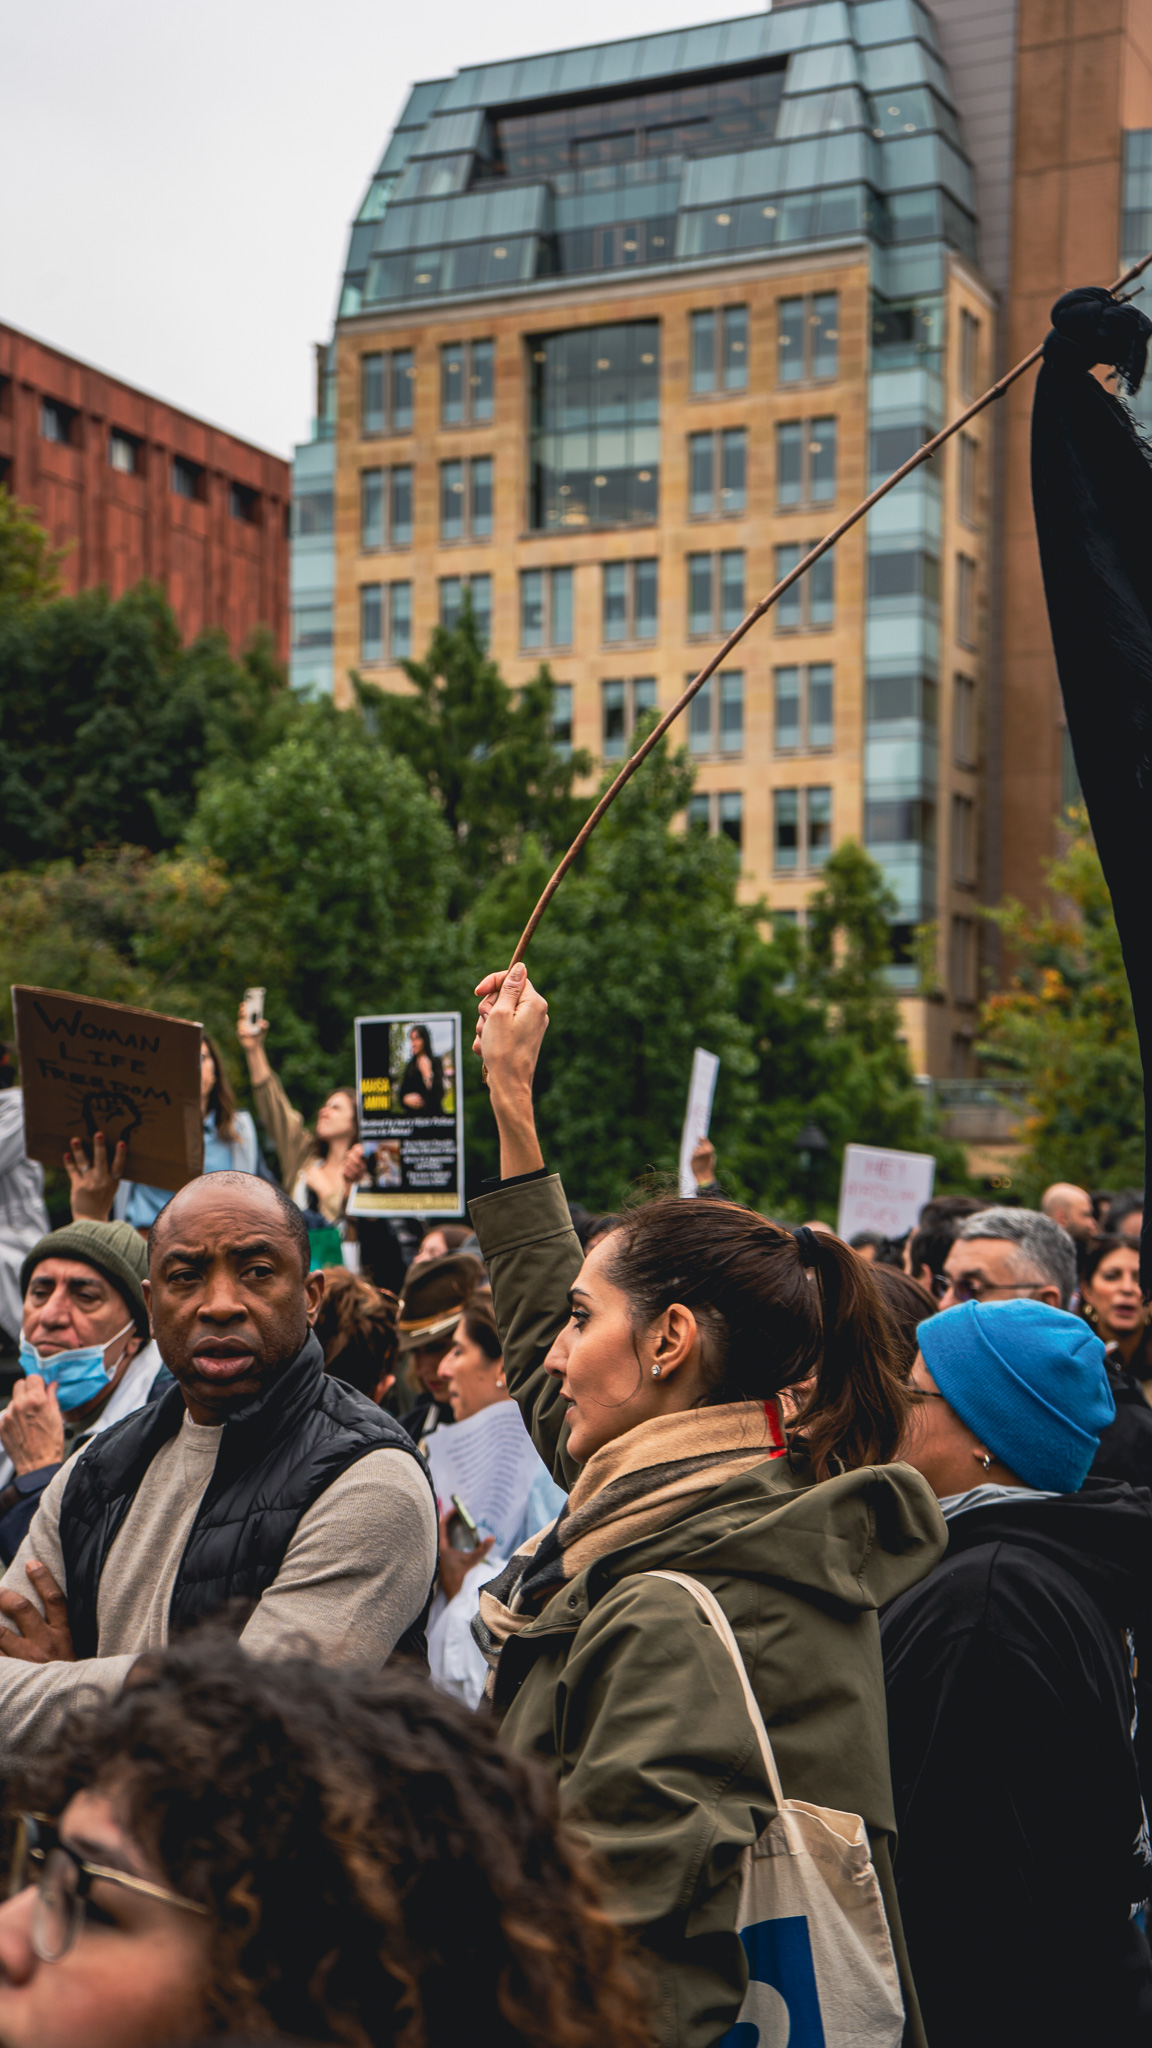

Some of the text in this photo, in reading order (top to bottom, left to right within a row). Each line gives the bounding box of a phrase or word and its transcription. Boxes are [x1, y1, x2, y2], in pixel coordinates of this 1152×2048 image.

[33, 1001, 160, 1053] WOMAN
[37, 1058, 171, 1105] FREEDOM
[59, 1041, 147, 1075] LIFE
